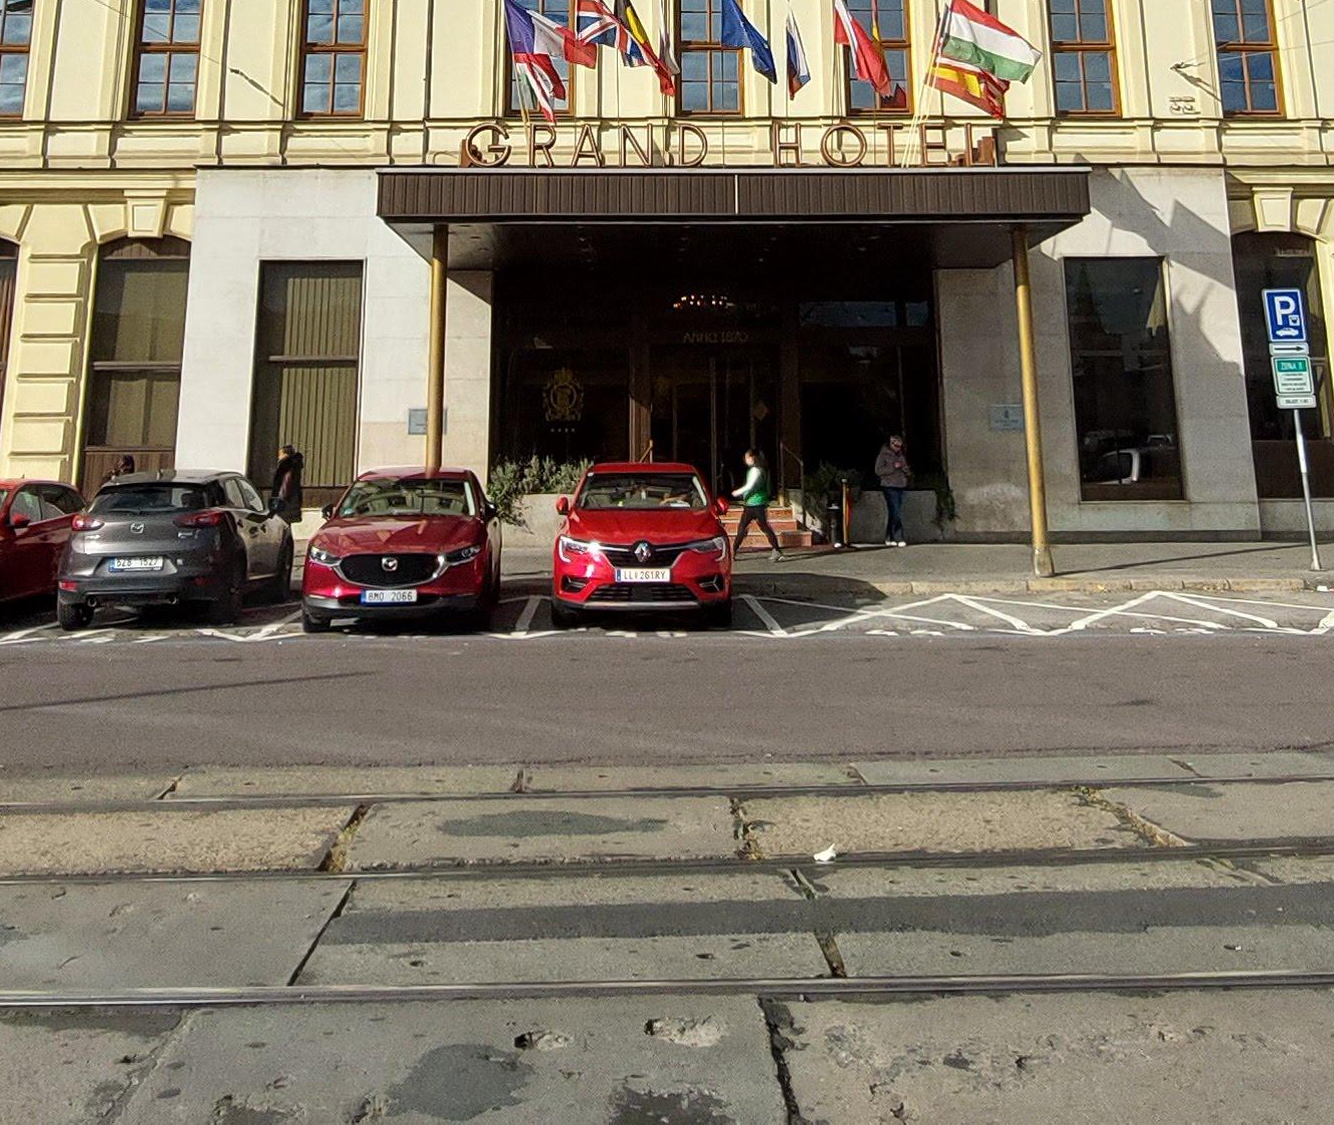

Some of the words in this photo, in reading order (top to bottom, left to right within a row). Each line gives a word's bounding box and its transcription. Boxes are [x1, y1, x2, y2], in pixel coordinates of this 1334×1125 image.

[465, 122, 708, 168] GRAND
[773, 122, 990, 168] HOTEL
[1274, 296, 1295, 326] P
[391, 591, 413, 601] 2066
